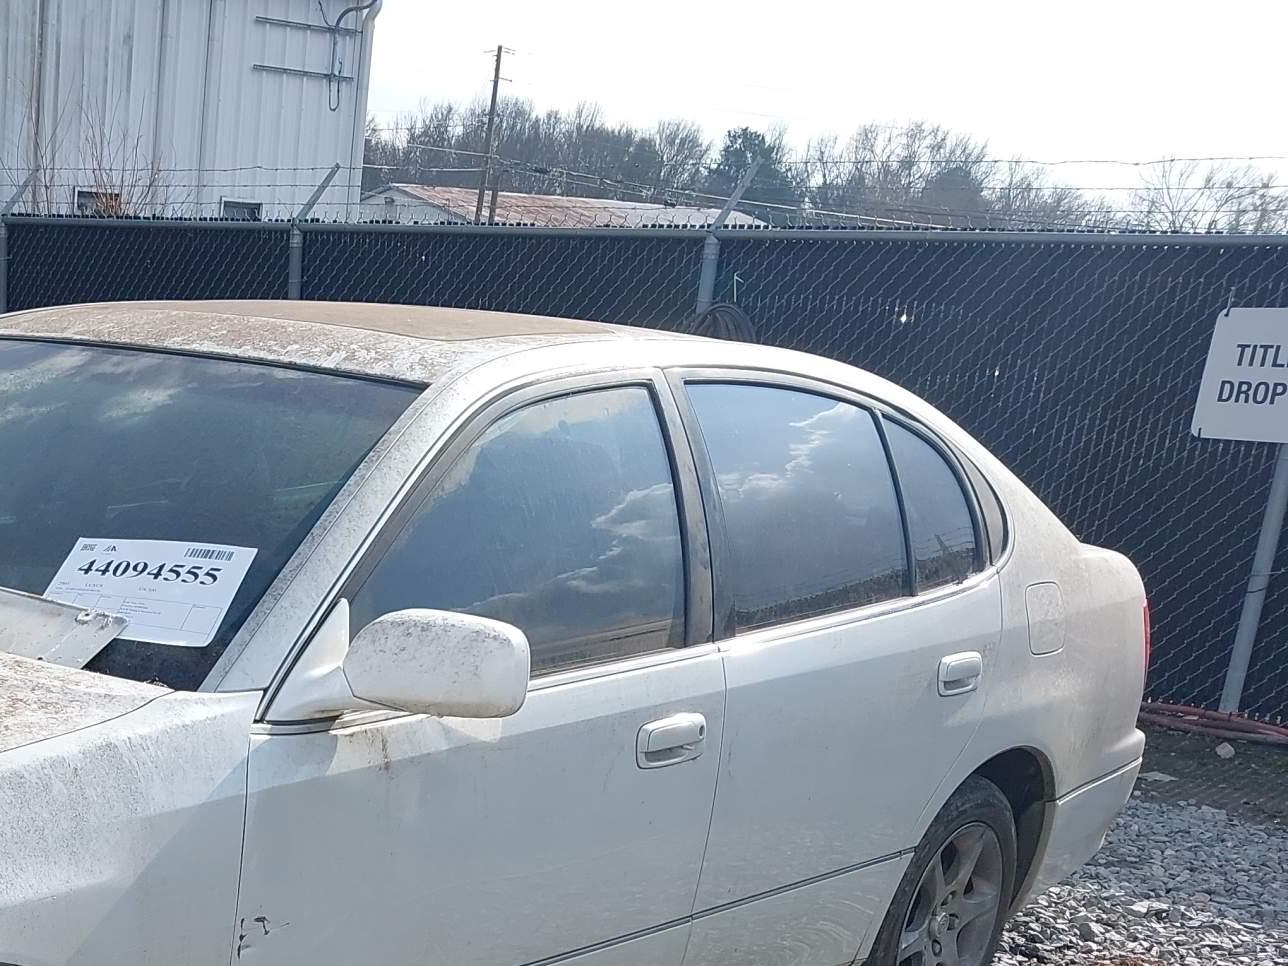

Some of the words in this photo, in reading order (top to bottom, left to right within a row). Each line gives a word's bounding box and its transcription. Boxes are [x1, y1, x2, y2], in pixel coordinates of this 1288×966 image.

[1236, 343, 1288, 369] TITL
[1216, 379, 1288, 406] DROP
[77, 558, 223, 587] 44094555
